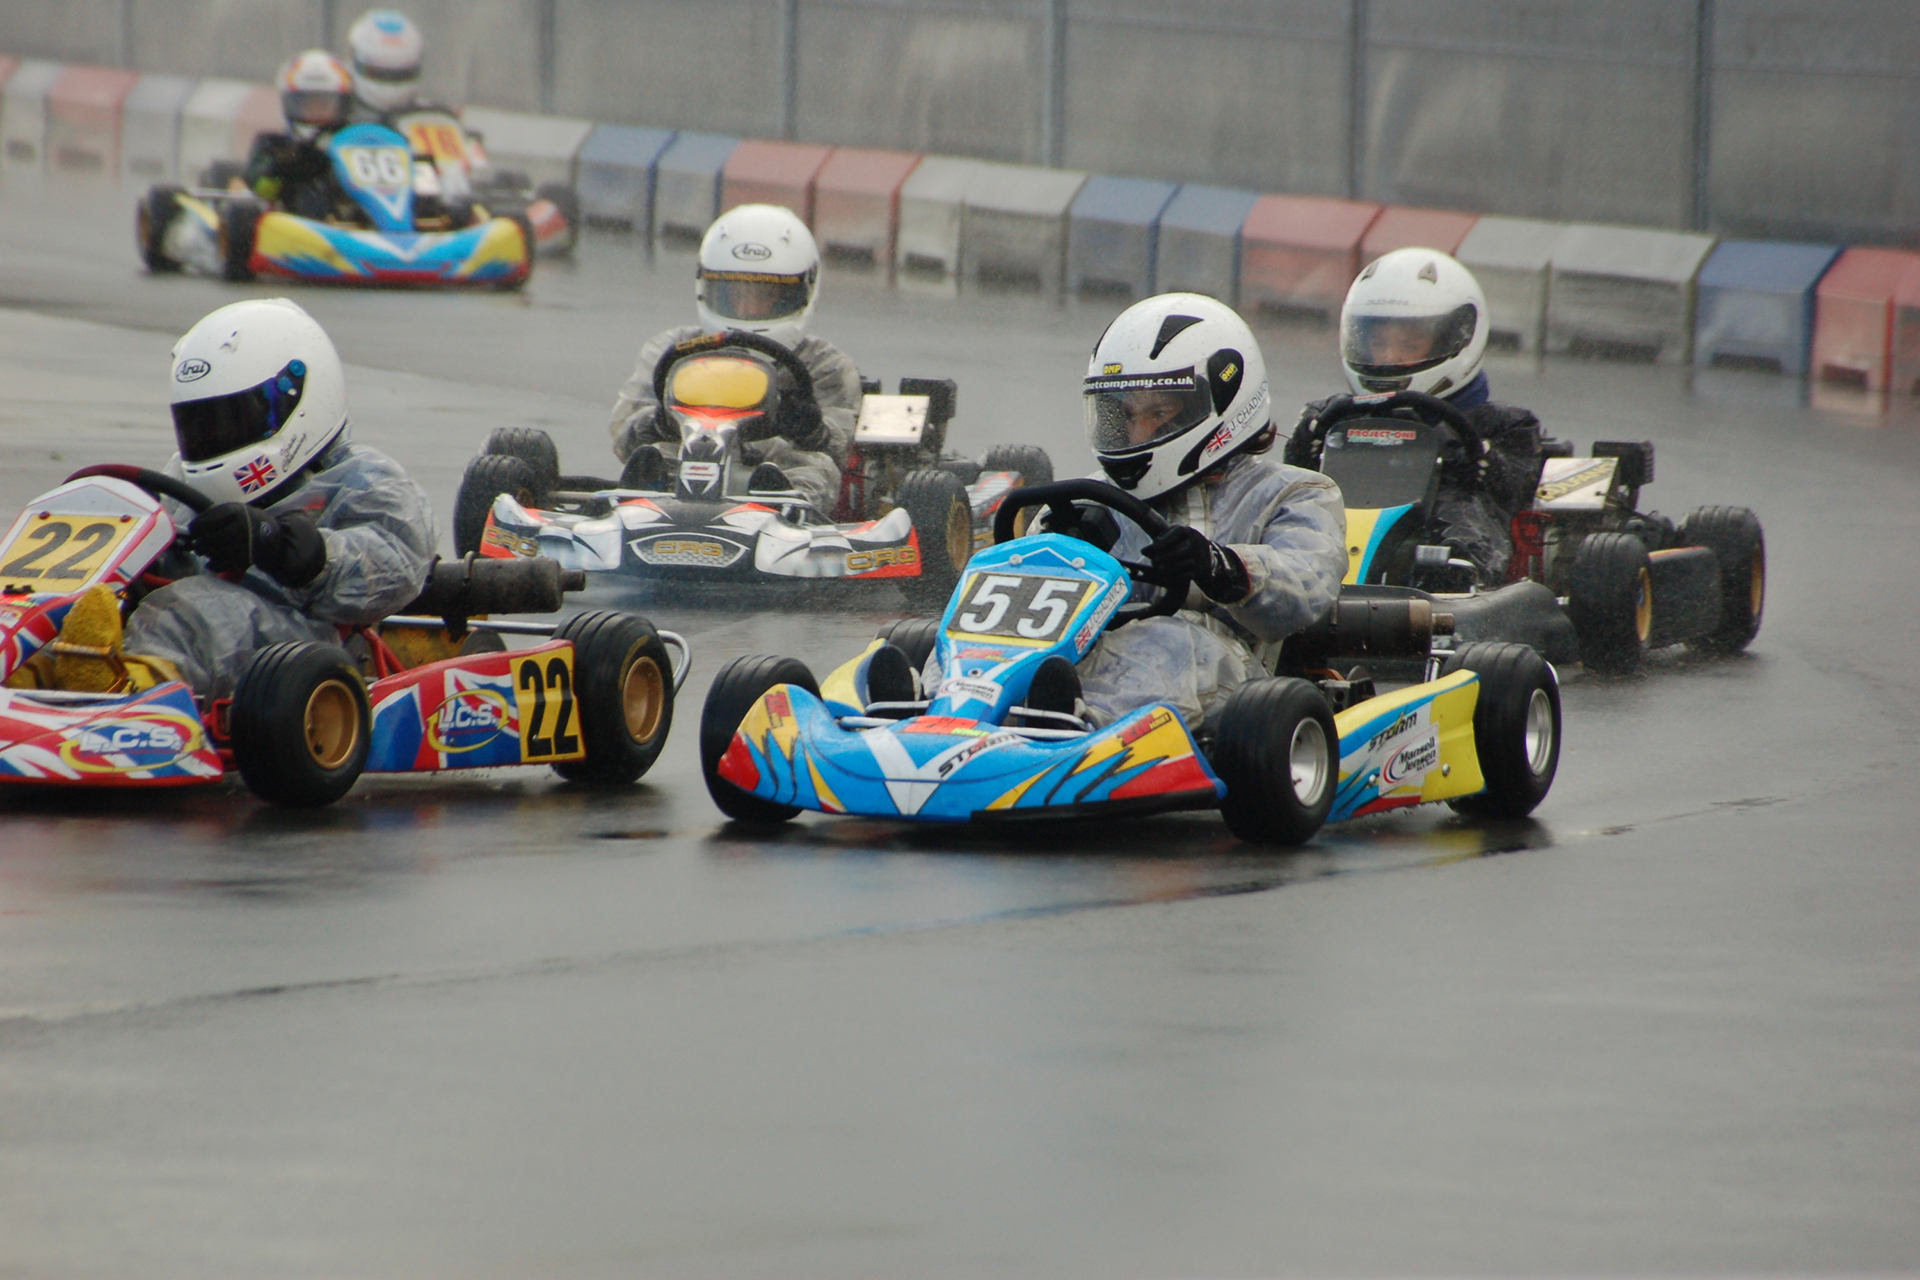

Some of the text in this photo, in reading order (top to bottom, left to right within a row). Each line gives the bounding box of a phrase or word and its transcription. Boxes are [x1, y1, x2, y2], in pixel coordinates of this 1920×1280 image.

[352, 149, 406, 184] 66
[178, 361, 205, 376] Arai
[1103, 364, 1122, 375] OMP
[1220, 363, 1237, 381] OMP
[1, 522, 116, 580] 22
[483, 526, 539, 557] CRG
[655, 541, 723, 557] CRG
[847, 546, 917, 569] CRG
[959, 575, 1080, 638] 55
[519, 657, 578, 758] 22
[1400, 735, 1435, 764] Mansell
[1402, 749, 1436, 774] Jensen
